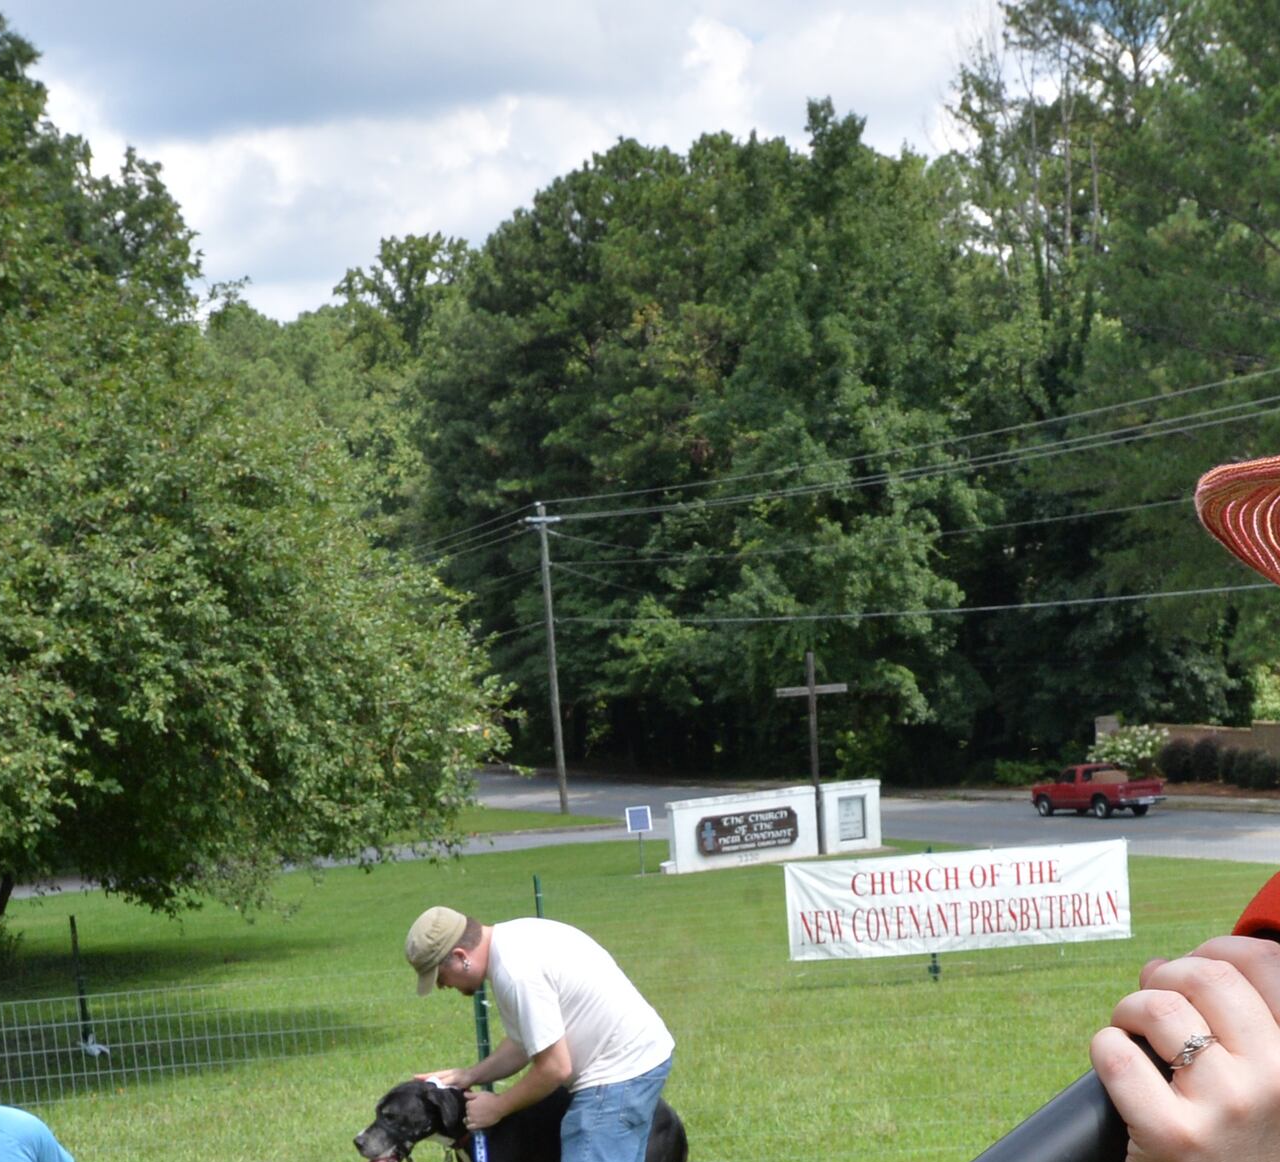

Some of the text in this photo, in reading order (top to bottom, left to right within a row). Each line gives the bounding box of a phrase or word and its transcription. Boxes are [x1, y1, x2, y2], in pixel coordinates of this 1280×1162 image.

[851, 860, 1061, 896] CHURCH OF THE
[800, 890, 1119, 945] NEW COVENANT PRESBYTERIAN
